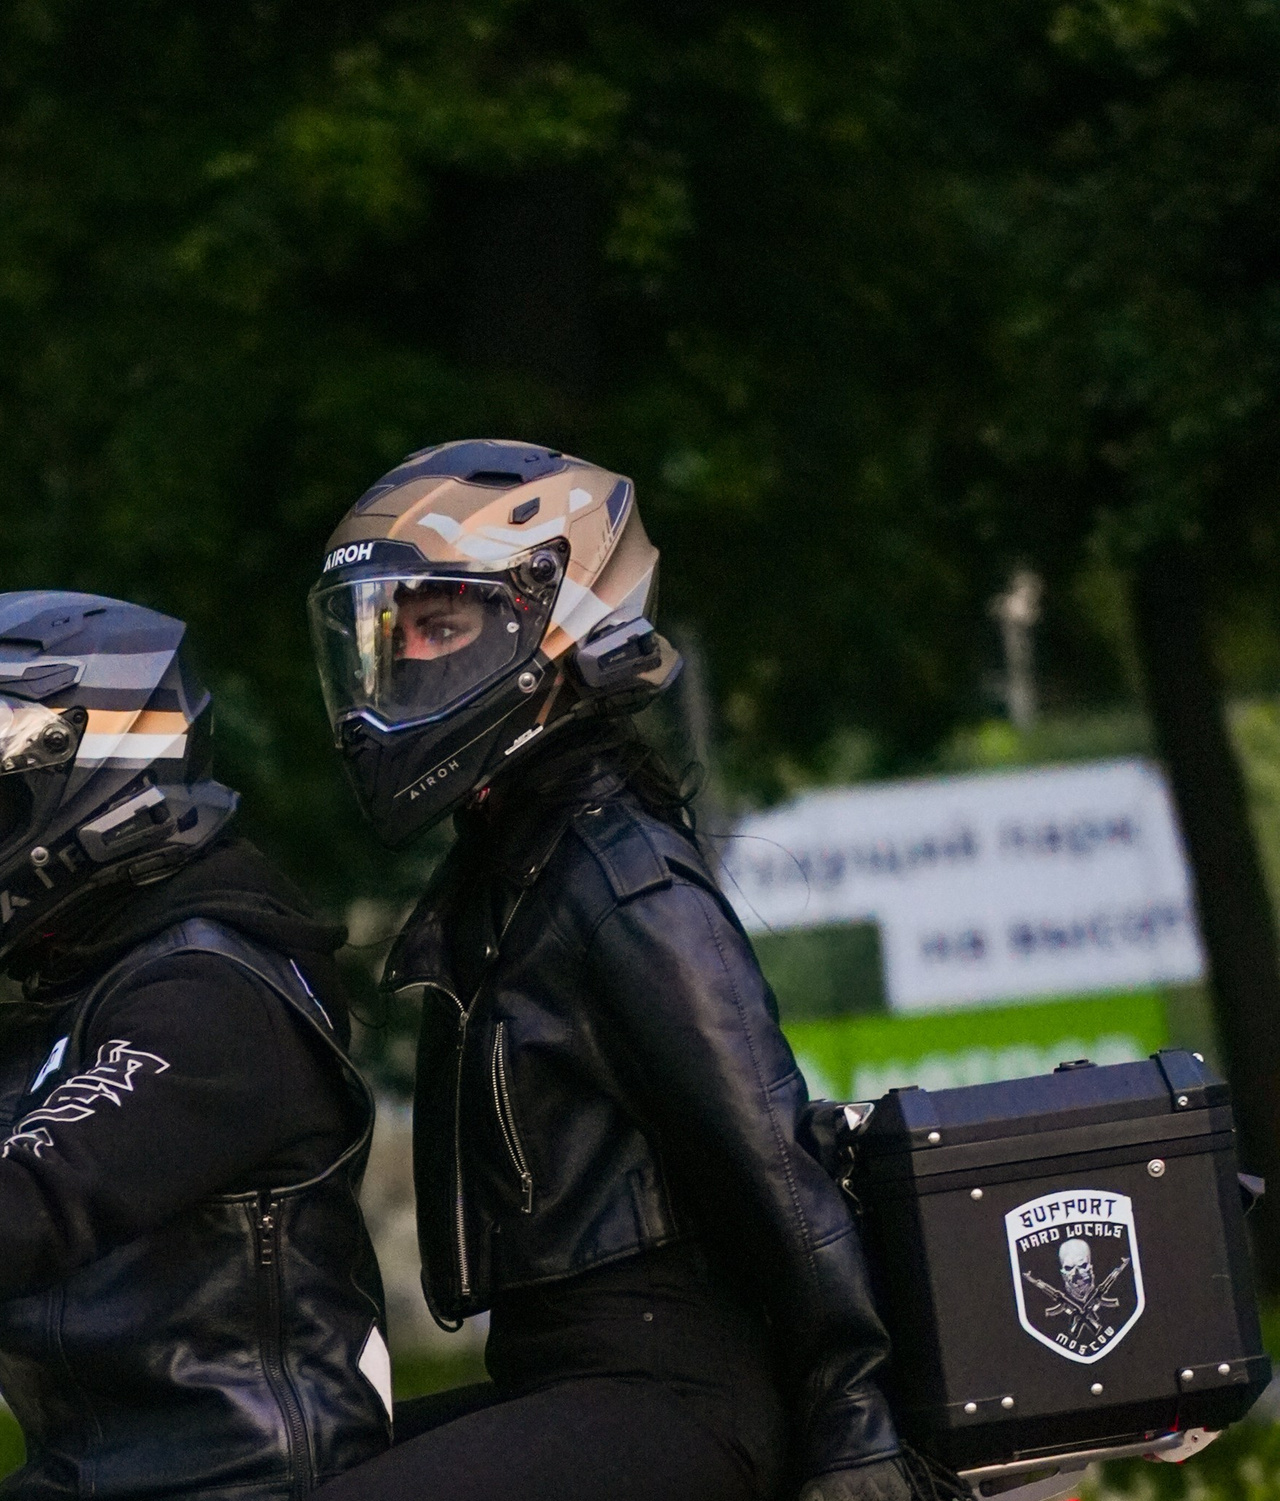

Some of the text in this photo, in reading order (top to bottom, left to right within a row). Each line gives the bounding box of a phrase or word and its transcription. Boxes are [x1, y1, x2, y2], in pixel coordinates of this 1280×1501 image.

[322, 542, 374, 574] AIROH
[410, 760, 459, 800] AIROH
[1019, 1198, 1117, 1228] SUPPORT
[1019, 1223, 1124, 1252] HARD LOCALS
[1055, 1325, 1115, 1355] MOSCOW
